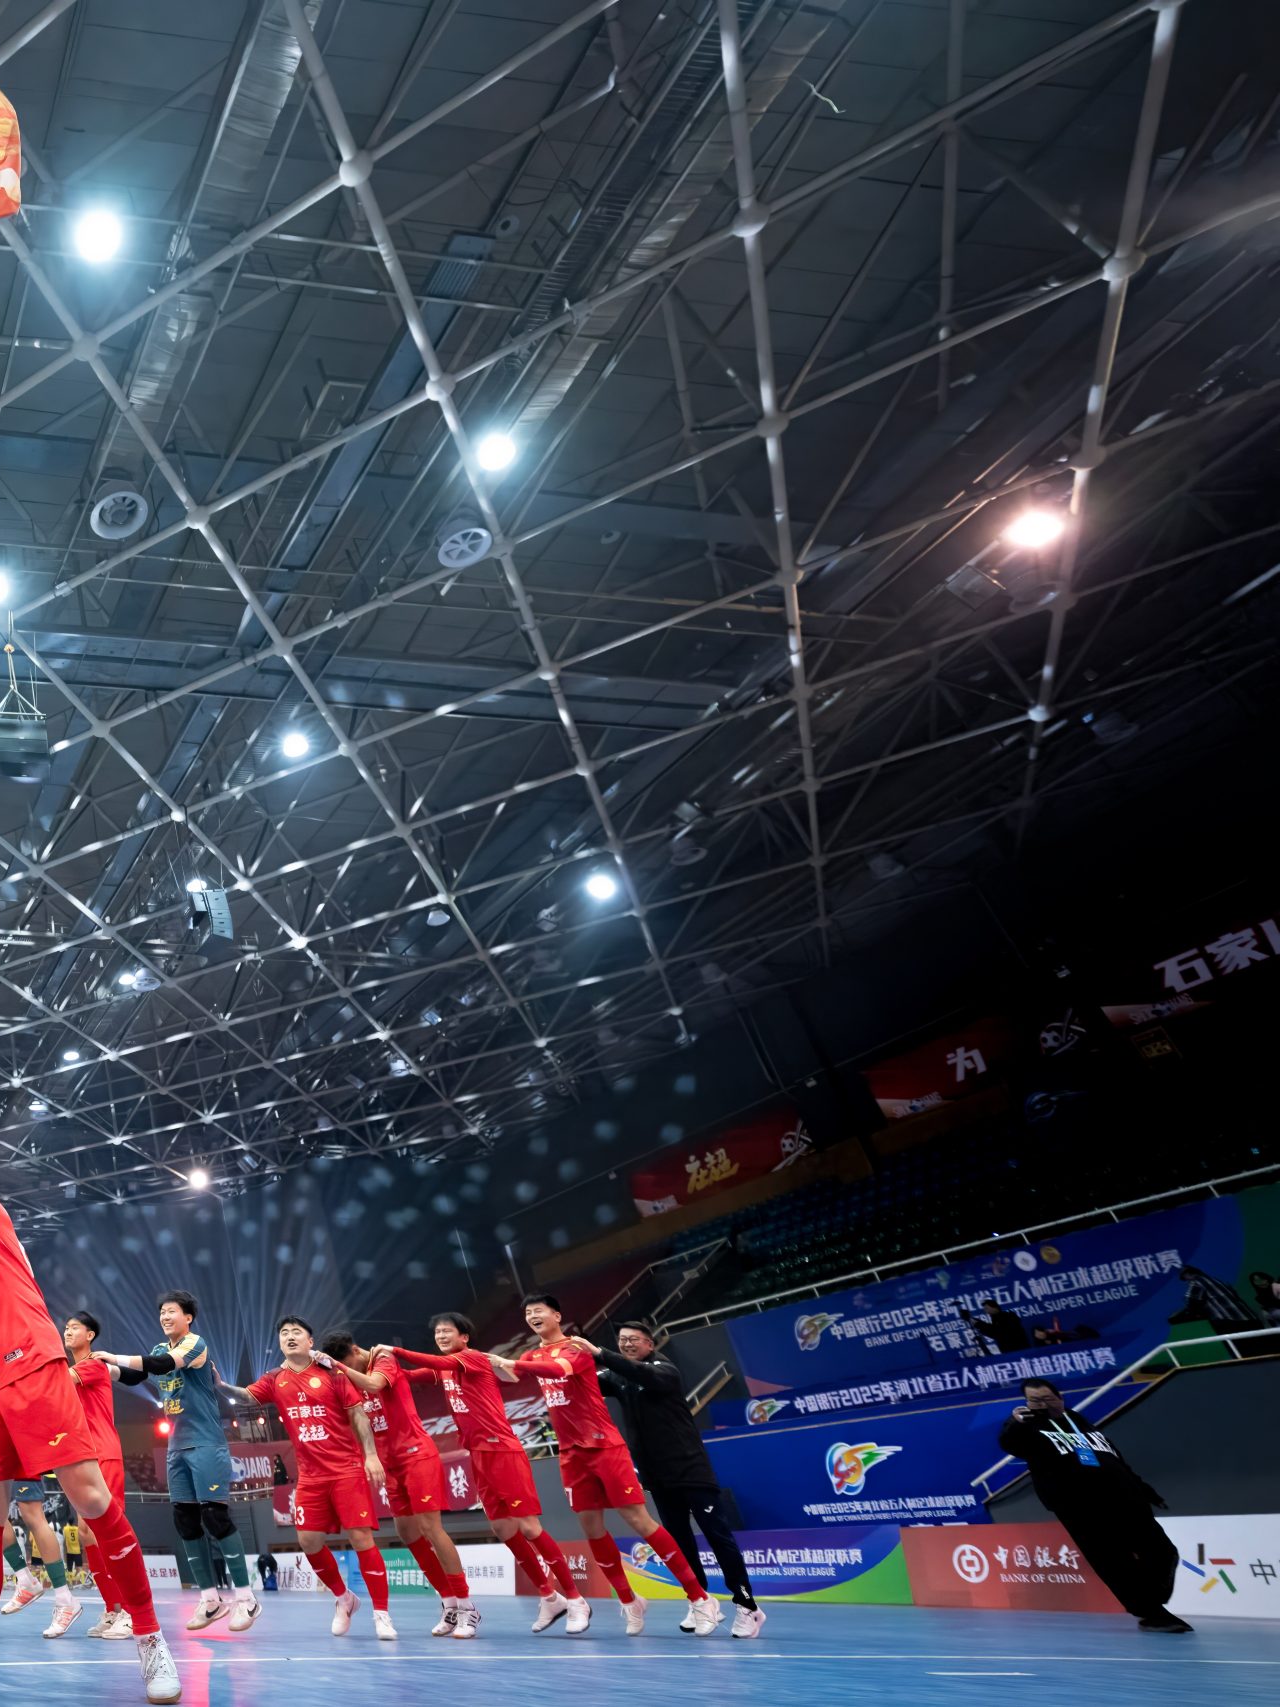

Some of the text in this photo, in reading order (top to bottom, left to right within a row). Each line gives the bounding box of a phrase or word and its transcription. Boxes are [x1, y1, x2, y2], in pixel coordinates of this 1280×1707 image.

[1152, 917, 1280, 994] 石家
[945, 1046, 988, 1082] 为
[864, 1335, 893, 1349] BANK
[1045, 1294, 1087, 1313] SUPER
[1086, 1284, 1140, 1305] LEAGUE
[297, 1392, 307, 1402] 23
[286, 1404, 327, 1419] 石家庄
[992, 1544, 1081, 1570] 中国银行
[756, 1567, 837, 1577] FUTSAL SUPER LEAGUE
[1000, 1573, 1086, 1584] BANK OF CHINA
[1249, 1558, 1277, 1586] 中
